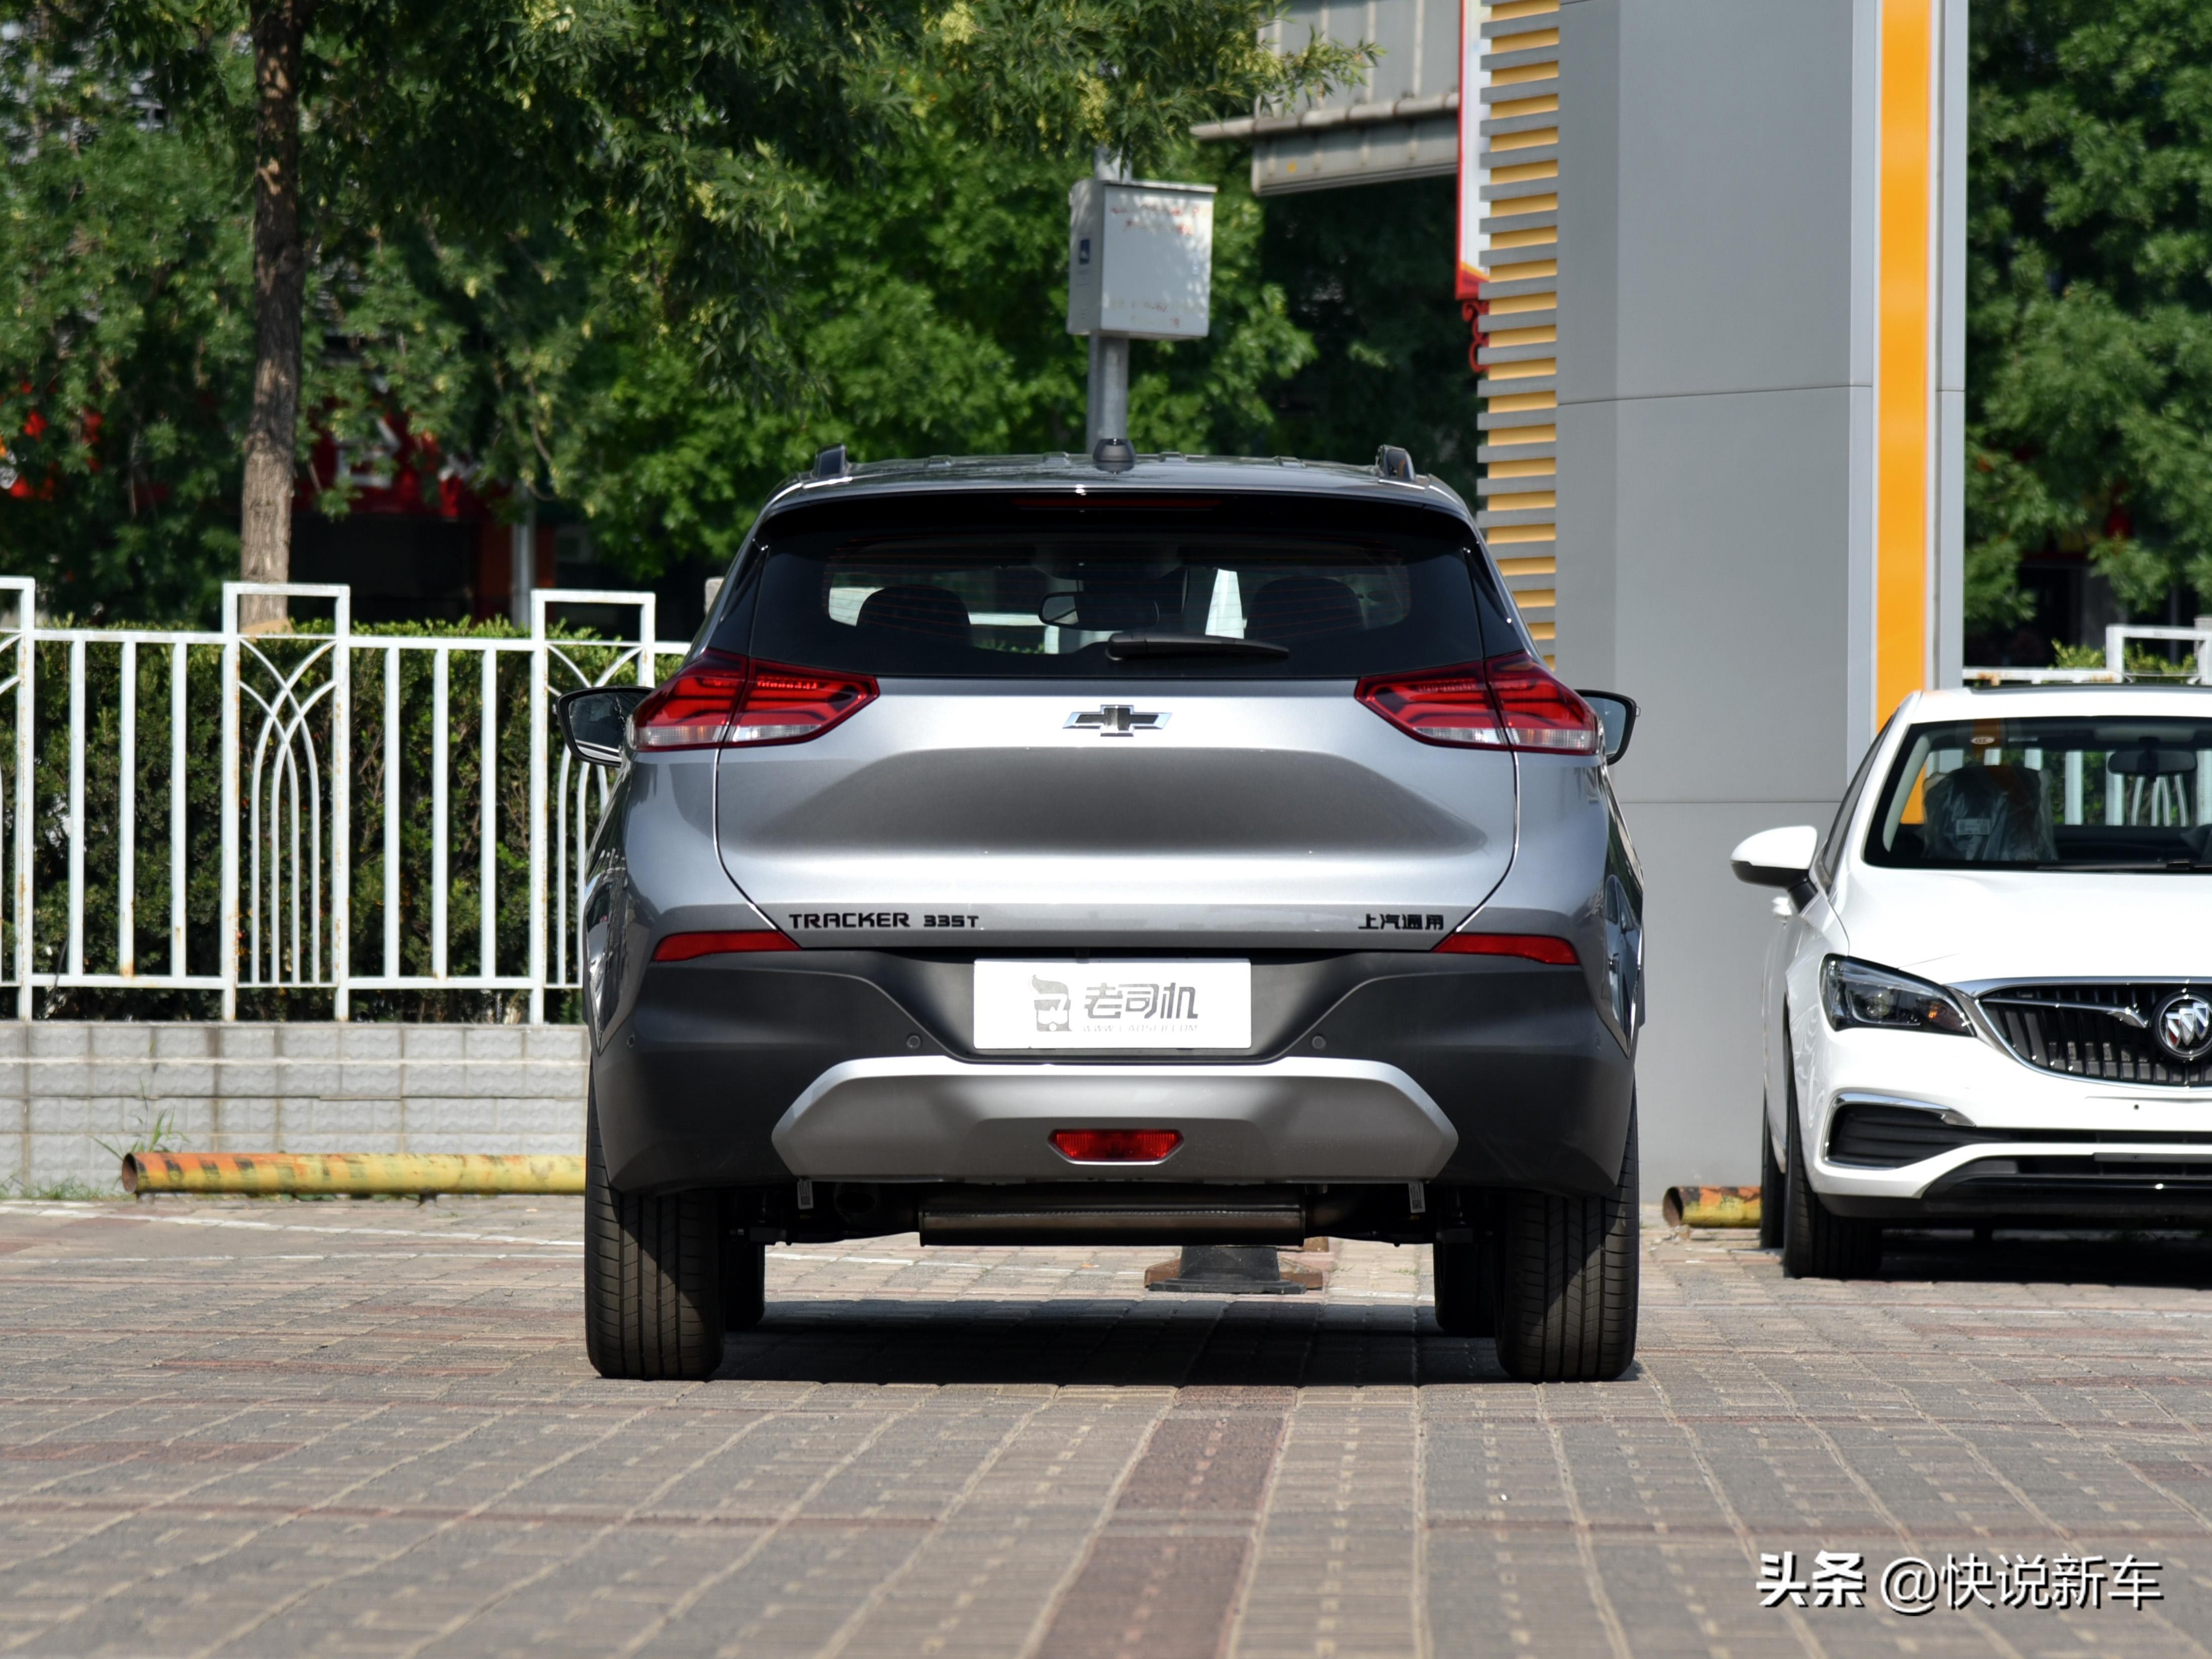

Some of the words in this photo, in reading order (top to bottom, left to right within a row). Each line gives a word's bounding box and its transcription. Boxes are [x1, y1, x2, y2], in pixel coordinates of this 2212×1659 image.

[789, 912, 910, 929] TRACKER
[924, 915, 979, 928] 335T
[1358, 913, 1444, 930] 上汽通用
[1084, 982, 1199, 1019] 老司机
